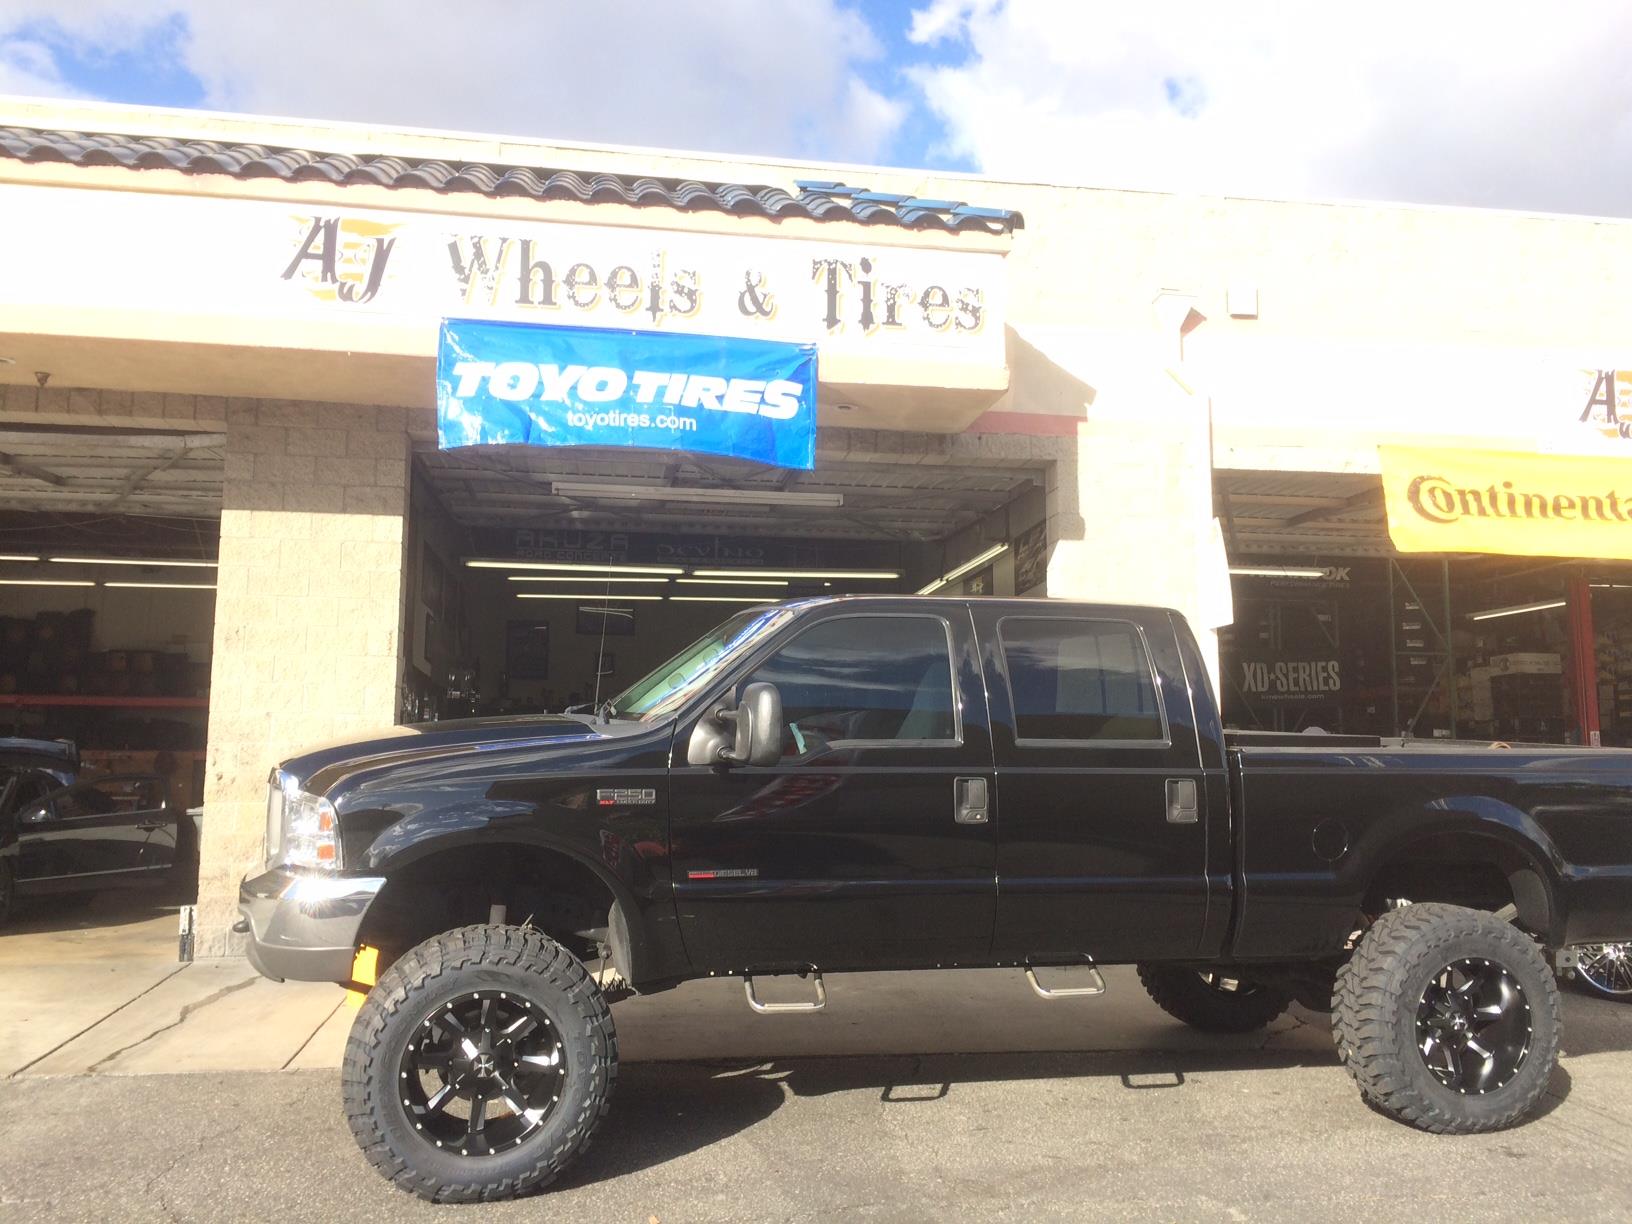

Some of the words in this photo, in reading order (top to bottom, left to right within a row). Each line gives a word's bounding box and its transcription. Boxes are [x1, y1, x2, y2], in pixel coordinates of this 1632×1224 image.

[280, 216, 396, 304] AJ
[443, 233, 702, 323] Wheels
[738, 268, 775, 317] &
[811, 257, 982, 331] Tires
[452, 361, 628, 403] TOYO
[631, 370, 804, 420] TIRES
[567, 410, 698, 432] toyotires.com
[1579, 369, 1632, 439] A
